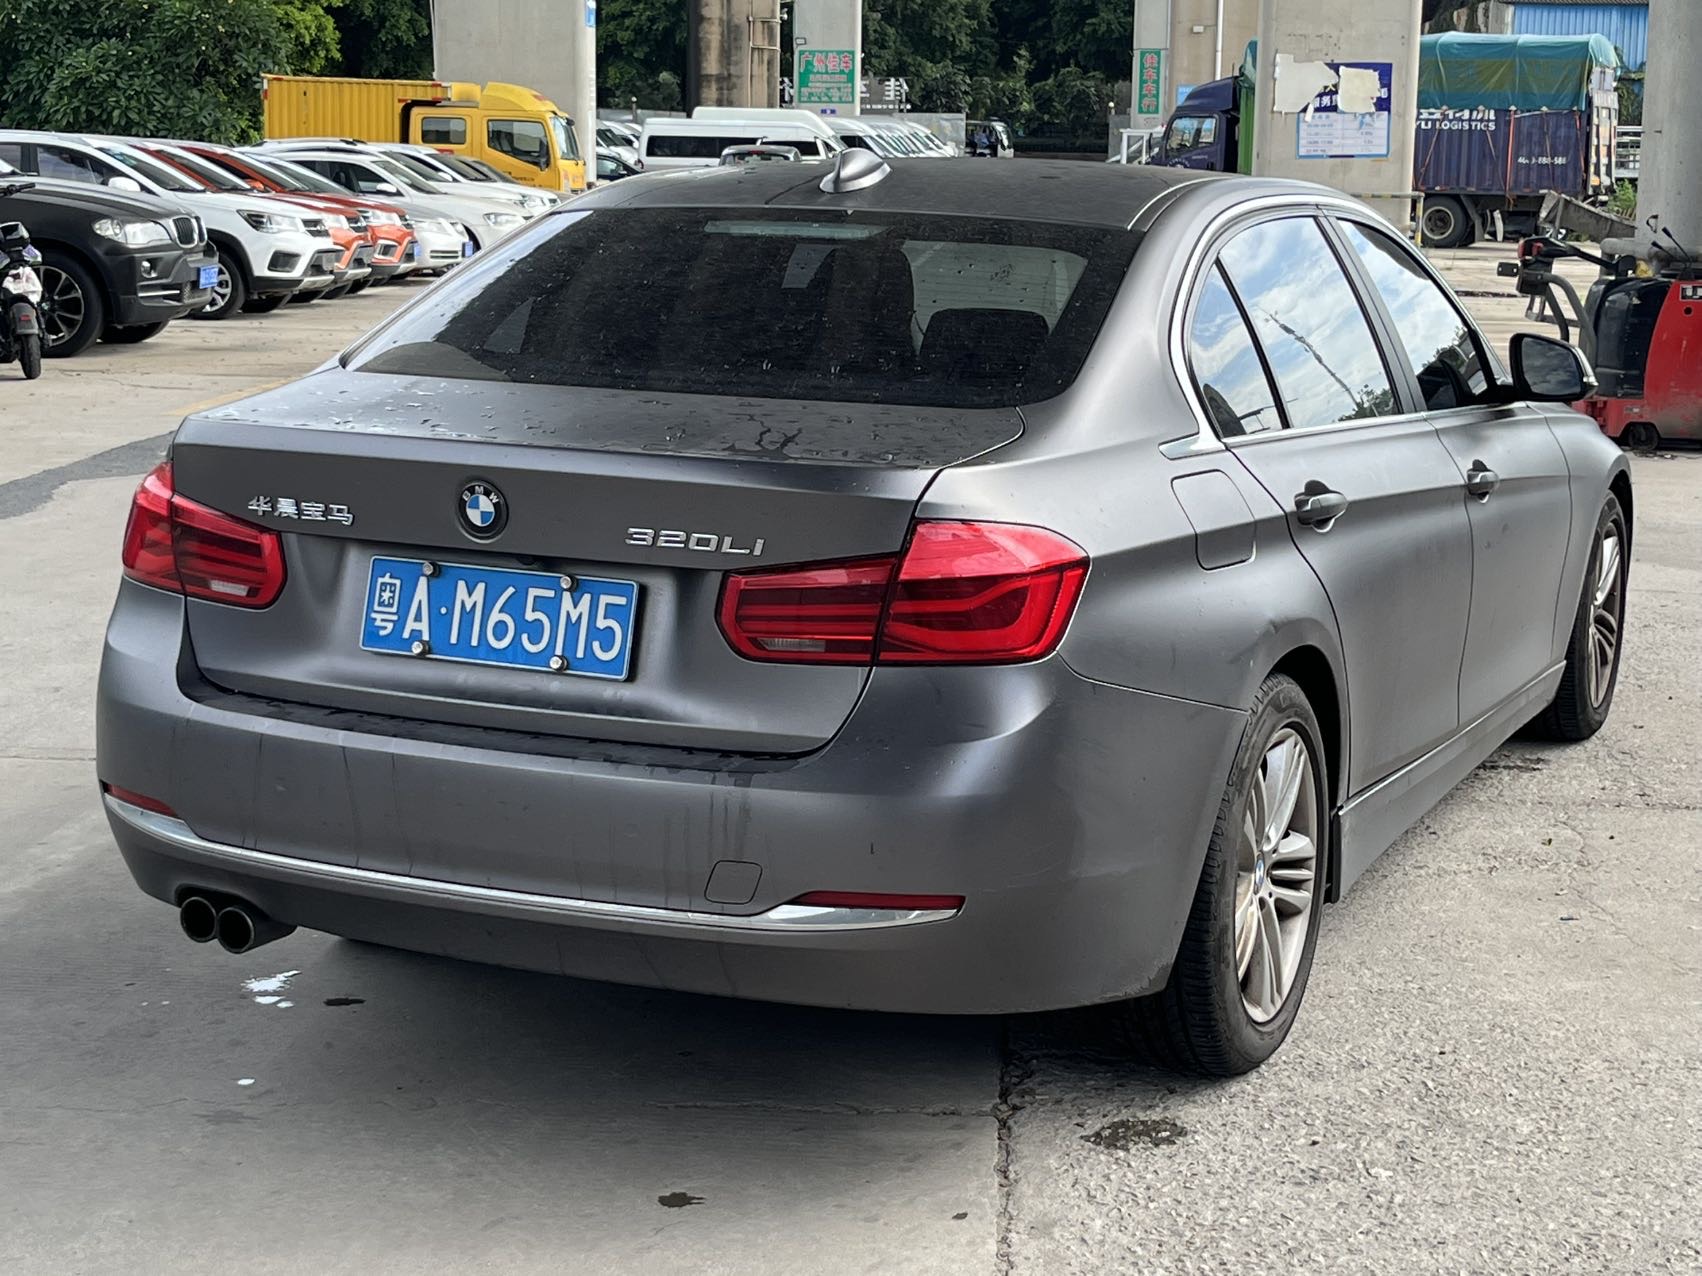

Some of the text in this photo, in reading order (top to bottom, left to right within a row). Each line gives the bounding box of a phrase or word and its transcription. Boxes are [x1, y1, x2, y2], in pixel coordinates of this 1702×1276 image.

[1435, 120, 1496, 131] LOGISTICS
[247, 495, 354, 526] 华晨宝马
